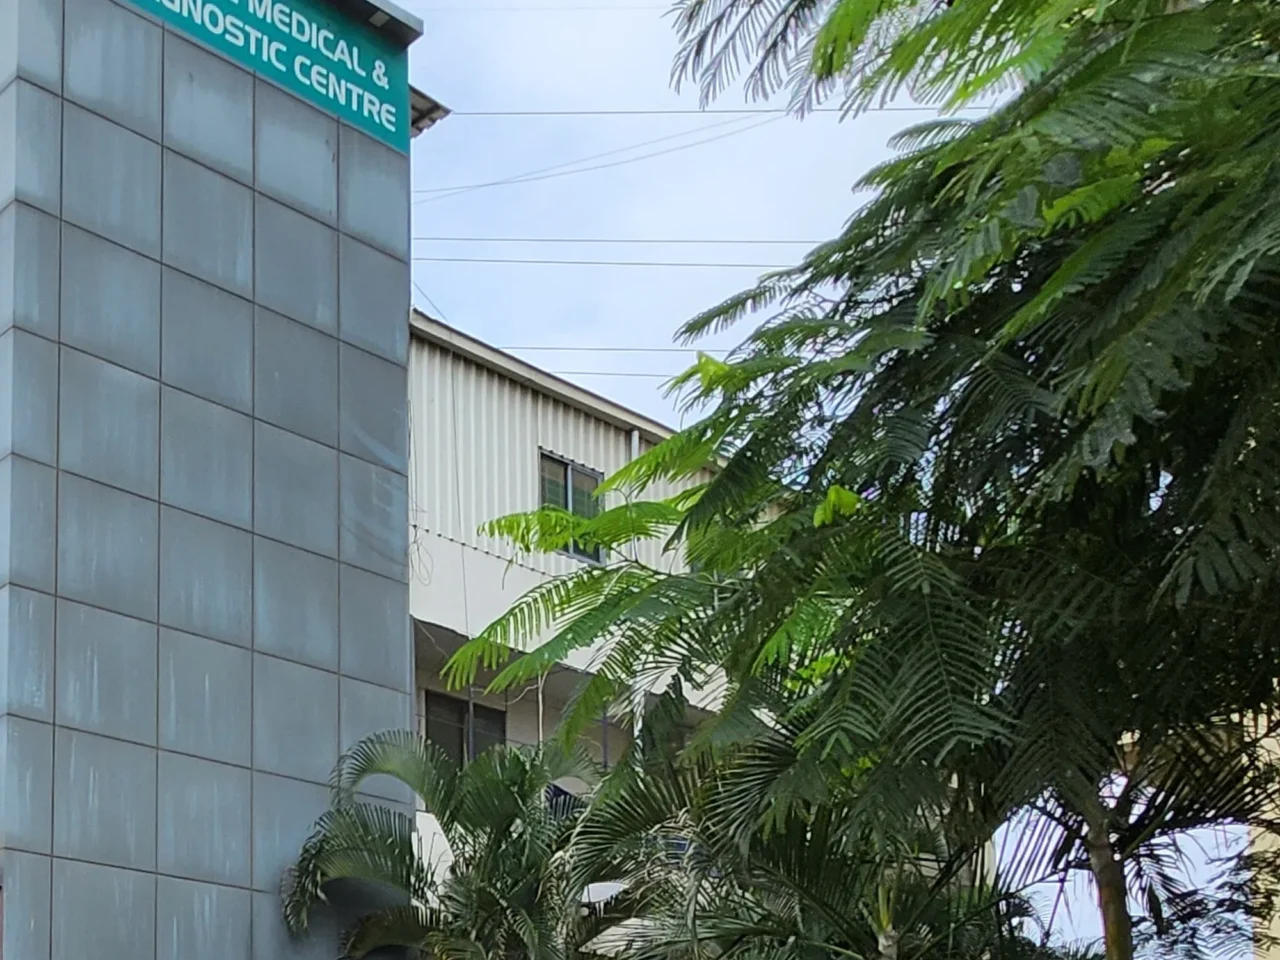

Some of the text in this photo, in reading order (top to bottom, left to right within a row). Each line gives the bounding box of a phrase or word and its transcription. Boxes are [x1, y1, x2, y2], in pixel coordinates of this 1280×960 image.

[247, 0, 389, 90] MEDICAL &
[294, 54, 396, 132] CENTRE
